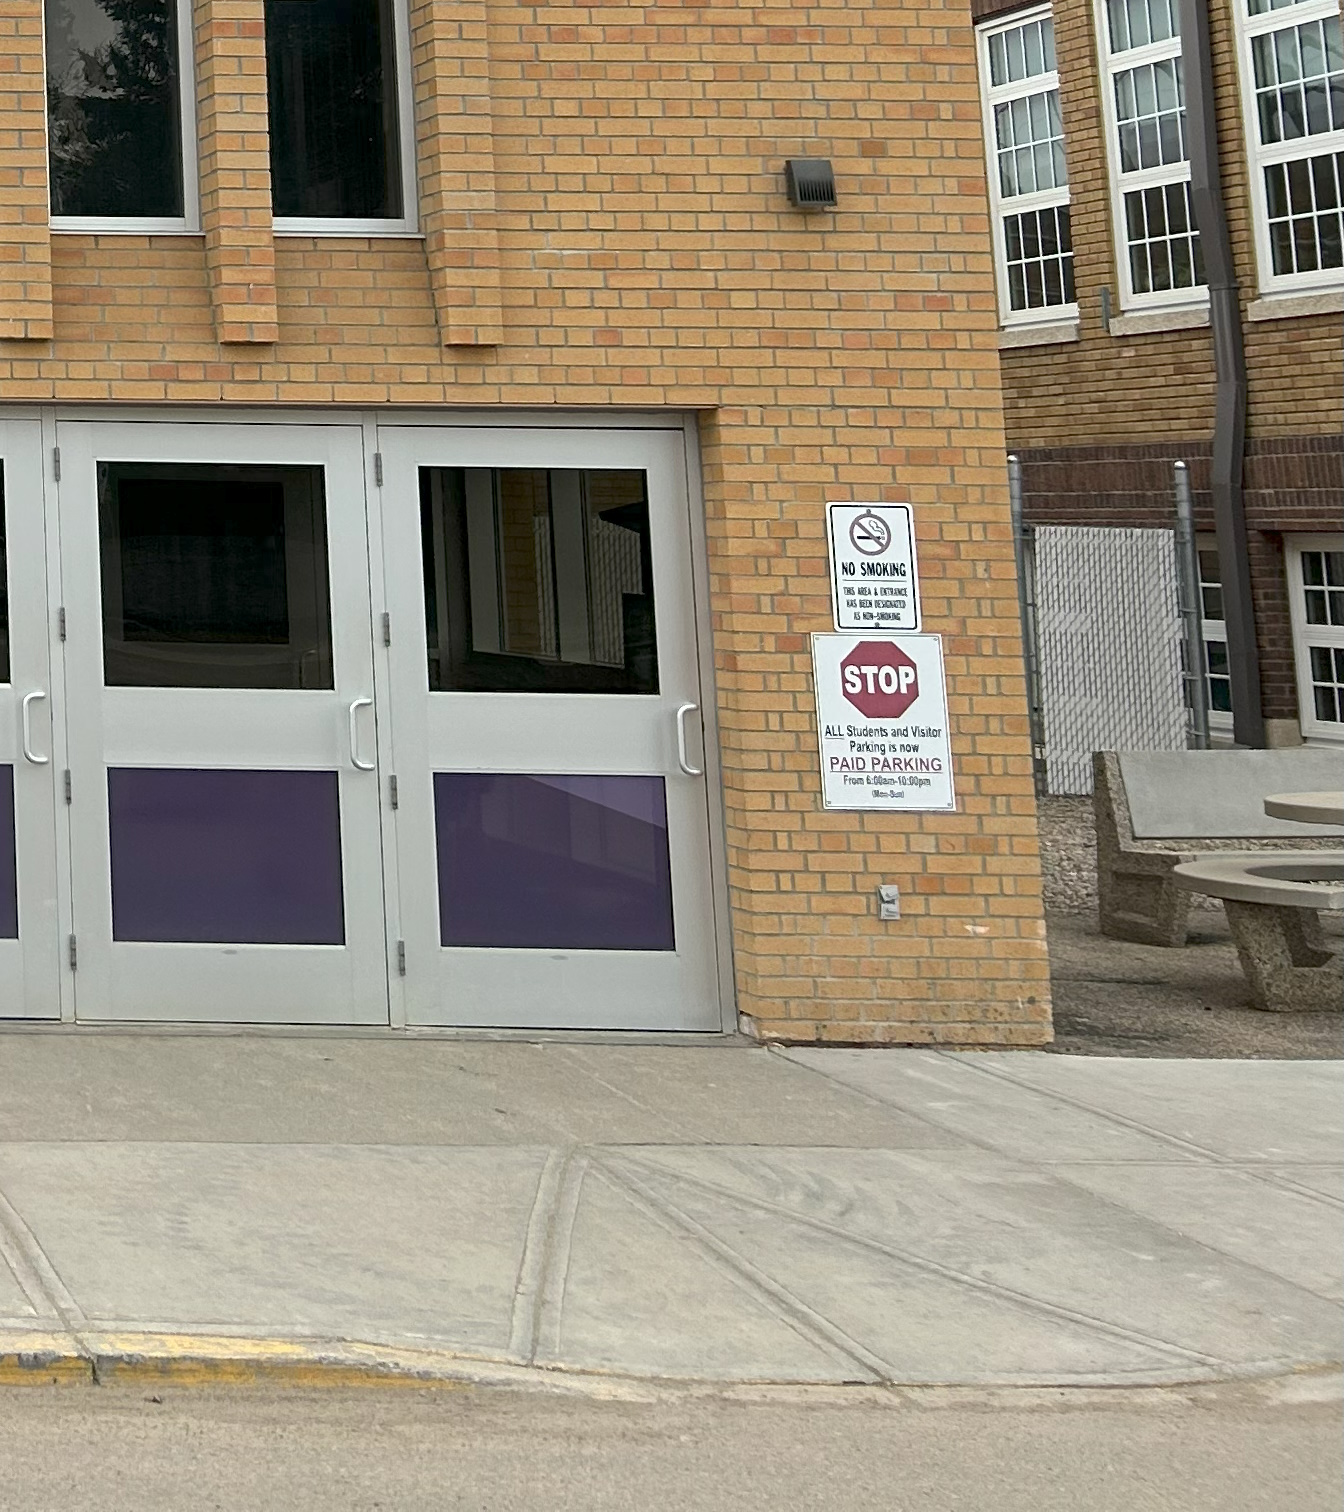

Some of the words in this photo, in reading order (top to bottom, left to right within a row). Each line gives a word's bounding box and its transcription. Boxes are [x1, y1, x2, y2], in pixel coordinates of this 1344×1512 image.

[842, 561, 855, 576] NO
[860, 562, 907, 577] SMOKING
[843, 586, 855, 595] THIS
[858, 587, 872, 596] AREA
[874, 587, 879, 596] &
[880, 587, 908, 597] ENTRANCE
[846, 599, 857, 608] HAS
[859, 599, 872, 608] BEEN
[874, 599, 906, 609] DESIGNATED
[854, 611, 861, 620] AS
[863, 611, 901, 621] NON-SMOKING
[844, 664, 915, 694] STOP
[825, 725, 845, 737] ALL
[846, 725, 888, 738] Students
[891, 726, 908, 738] and
[910, 726, 942, 738] Visitor
[849, 740, 886, 755] Parking
[889, 741, 897, 753] is
[899, 744, 919, 753] now
[830, 757, 866, 771] PAID
[871, 757, 942, 772] PARKING
[843, 775, 864, 785] From
